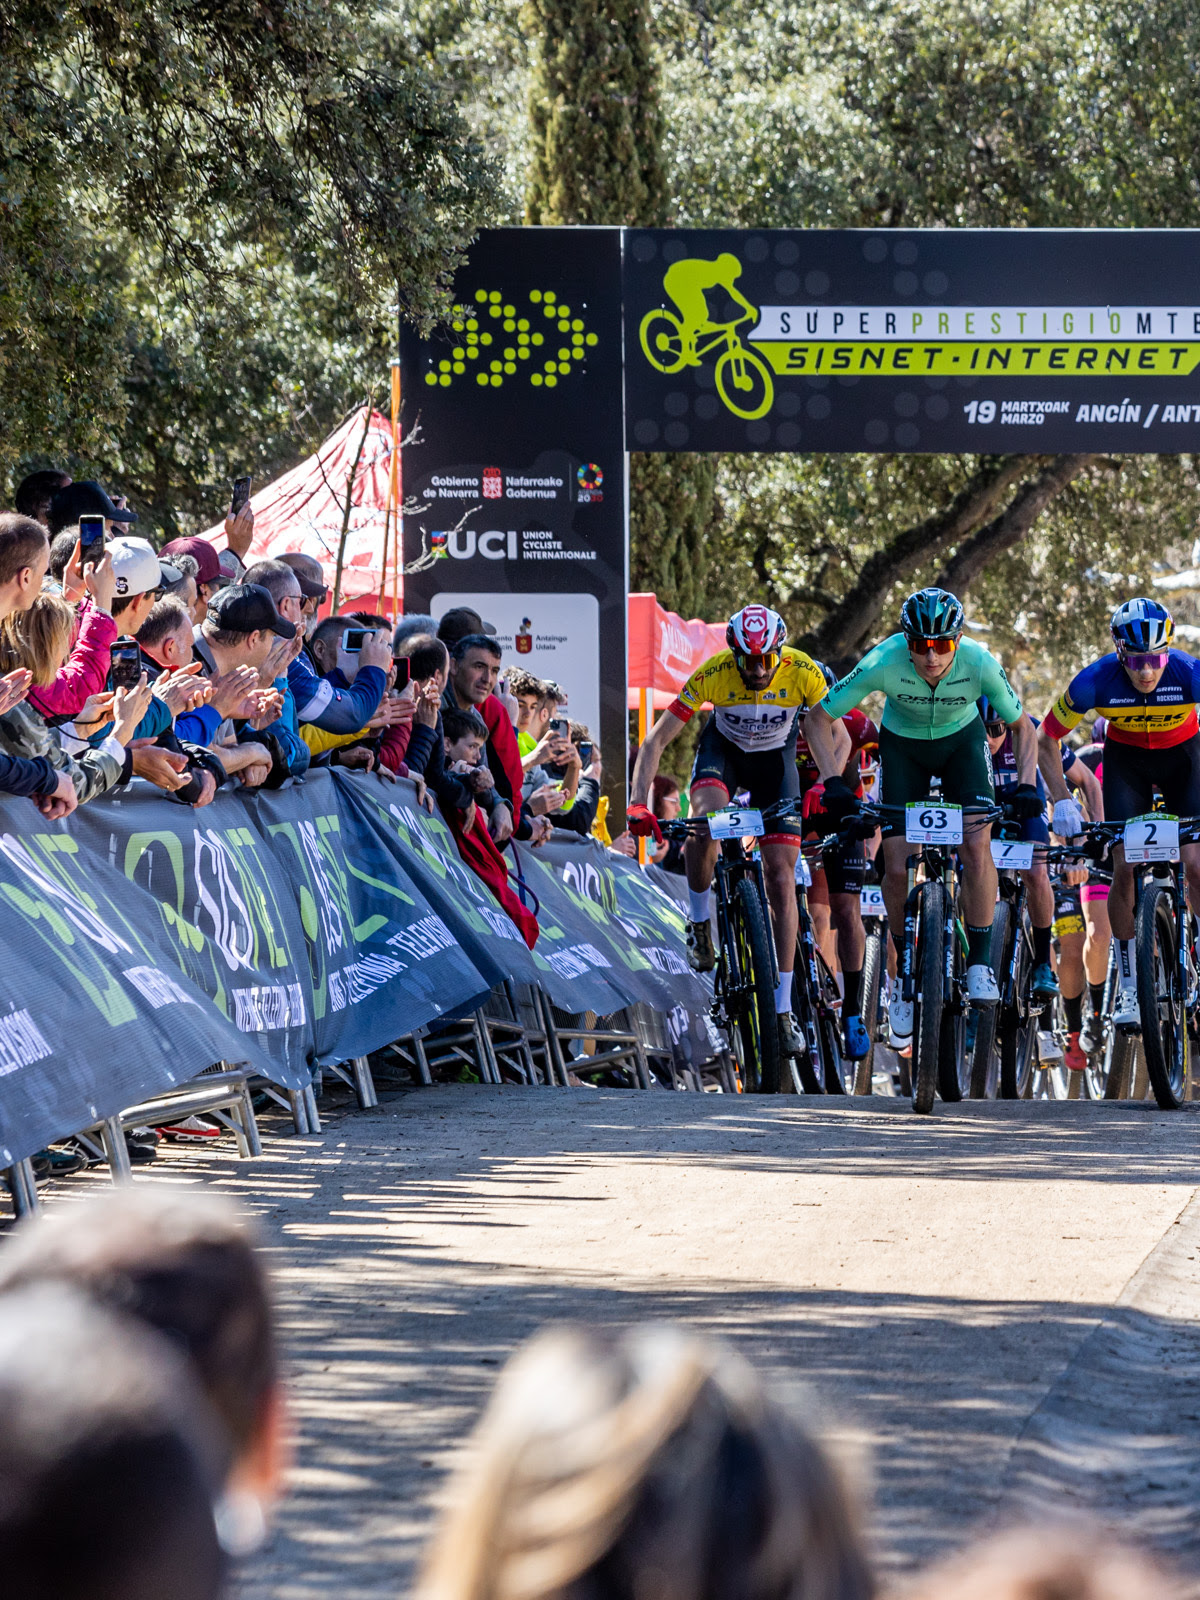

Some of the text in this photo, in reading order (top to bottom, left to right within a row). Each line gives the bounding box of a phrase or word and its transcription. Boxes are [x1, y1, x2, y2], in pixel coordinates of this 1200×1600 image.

[963, 400, 996, 424] 19
[1000, 401, 1070, 414] MARTXOAK
[1076, 398, 1142, 424] ANCÍN
[1000, 412, 1046, 425] MARZO
[430, 476, 563, 487] Gobierno Nafarroako
[422, 487, 557, 498] de Navarra Gobernua
[447, 531, 553, 560] UCI UNION
[522, 541, 562, 550] CYCLISTE
[522, 550, 597, 560] INTERNATIONALE
[1104, 711, 1187, 723] TREK
[729, 812, 742, 827] 5
[918, 809, 948, 829] 63
[1144, 823, 1158, 846] 2
[1001, 843, 1015, 857] 7
[861, 891, 881, 904] 16
